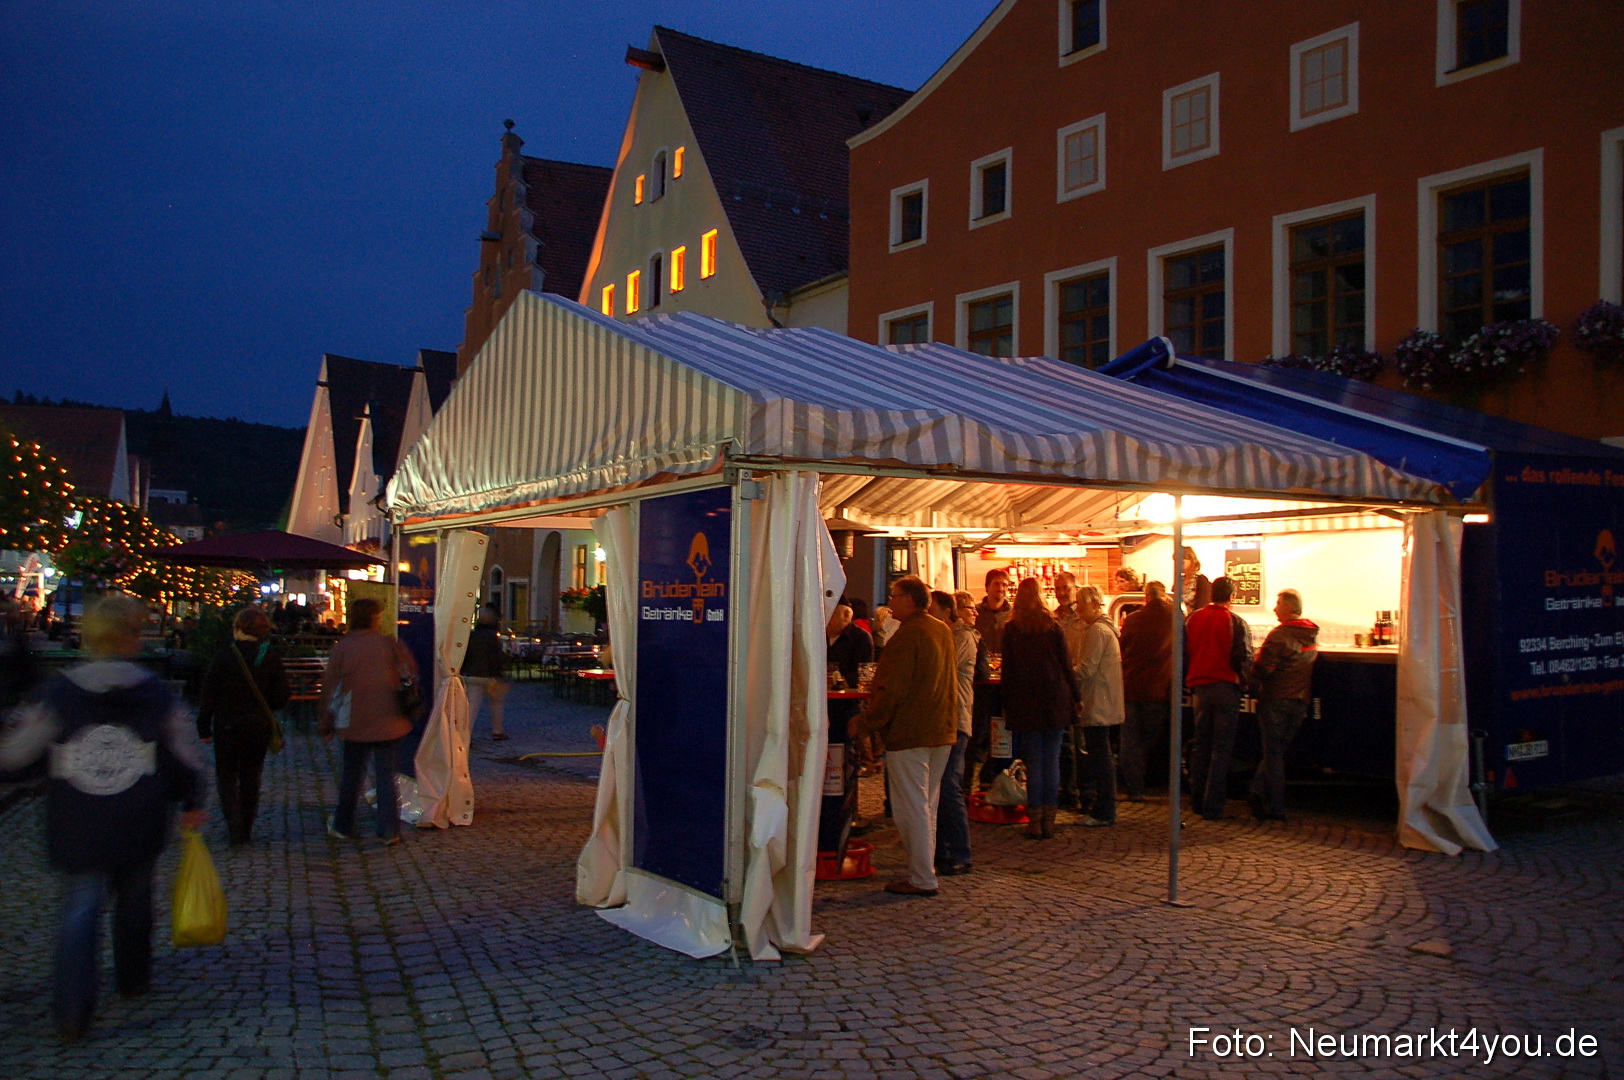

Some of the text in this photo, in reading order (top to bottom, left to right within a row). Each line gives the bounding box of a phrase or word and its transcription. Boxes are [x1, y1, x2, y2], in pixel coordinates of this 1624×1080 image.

[1522, 465, 1545, 483] das
[641, 578, 725, 598] Brüderlein
[641, 605, 724, 621] Getränke GmbH
[1545, 596, 1602, 611] Getränke
[1519, 637, 1548, 653] 92334
[1548, 635, 1590, 651] Berching
[1594, 633, 1614, 647] Zum
[1529, 660, 1546, 675] Tel.
[1604, 655, 1620, 669] Fax
